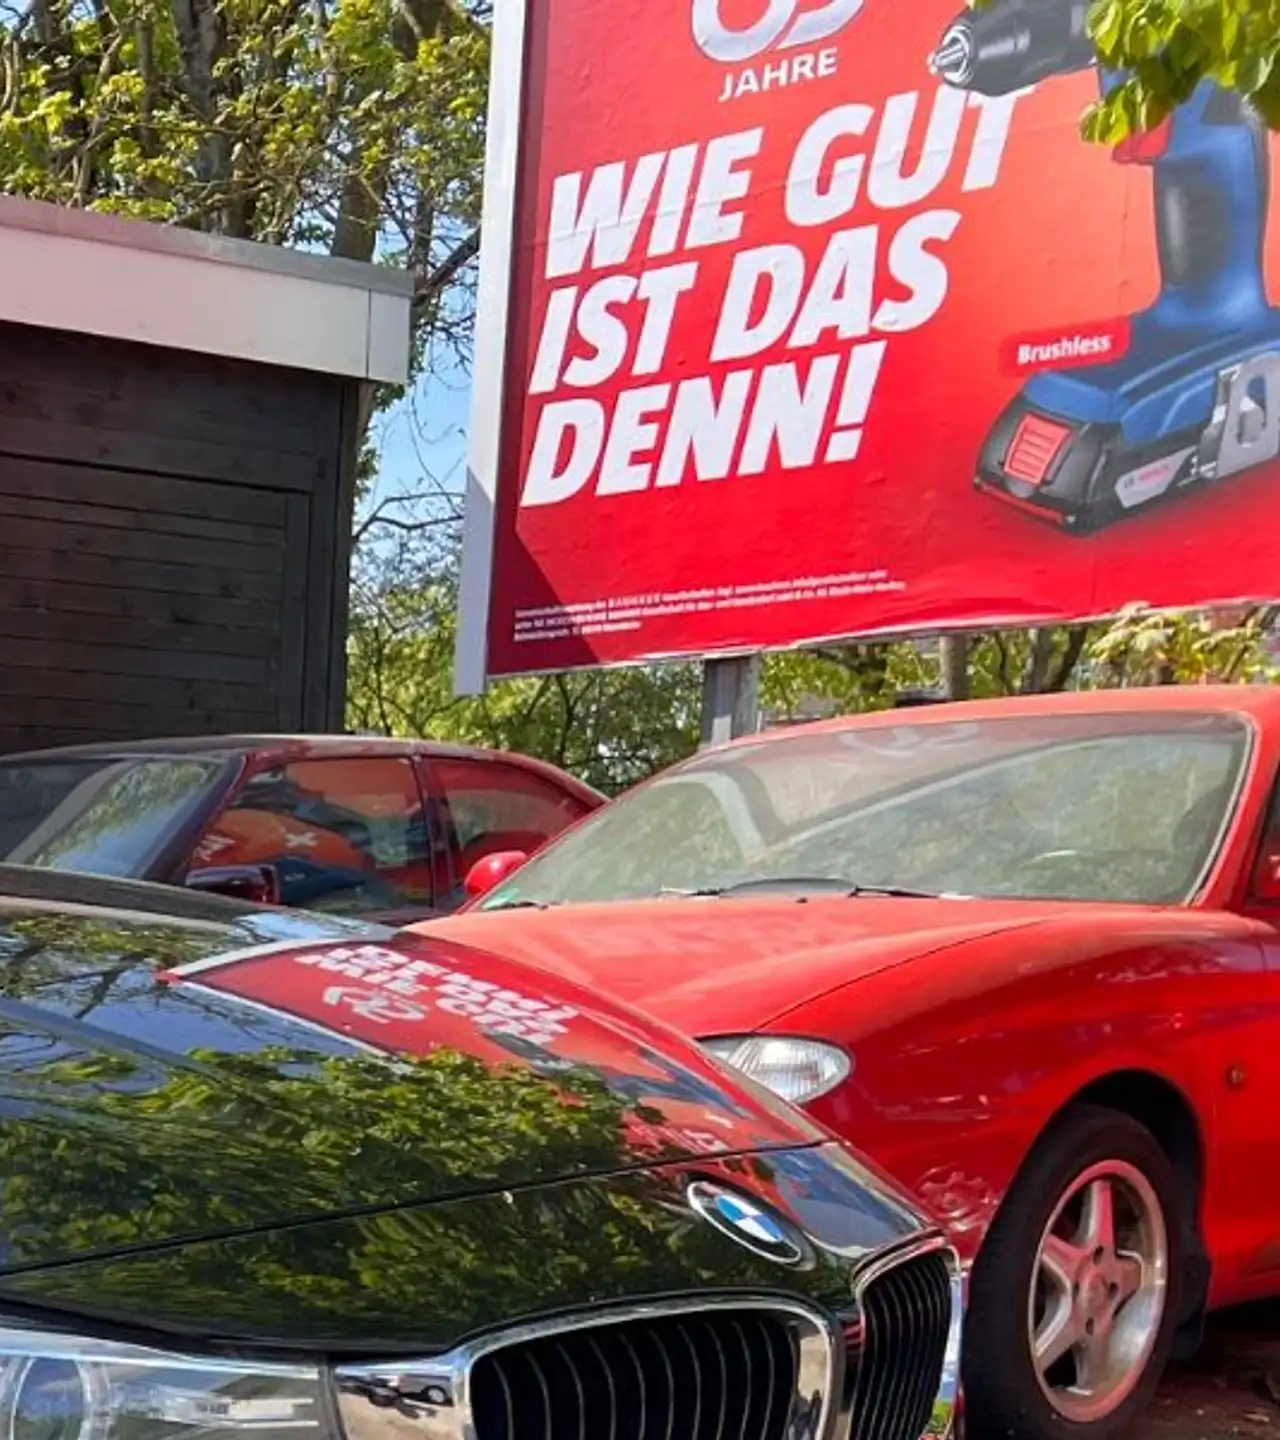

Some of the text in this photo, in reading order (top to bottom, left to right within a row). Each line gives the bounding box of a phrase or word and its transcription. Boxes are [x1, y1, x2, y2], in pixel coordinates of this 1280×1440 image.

[718, 47, 838, 102] JAHRE
[545, 82, 1034, 279] WIE GUT
[529, 210, 962, 394] IST DAS
[1017, 333, 1114, 366] Brushless
[520, 340, 886, 508] DENN!
